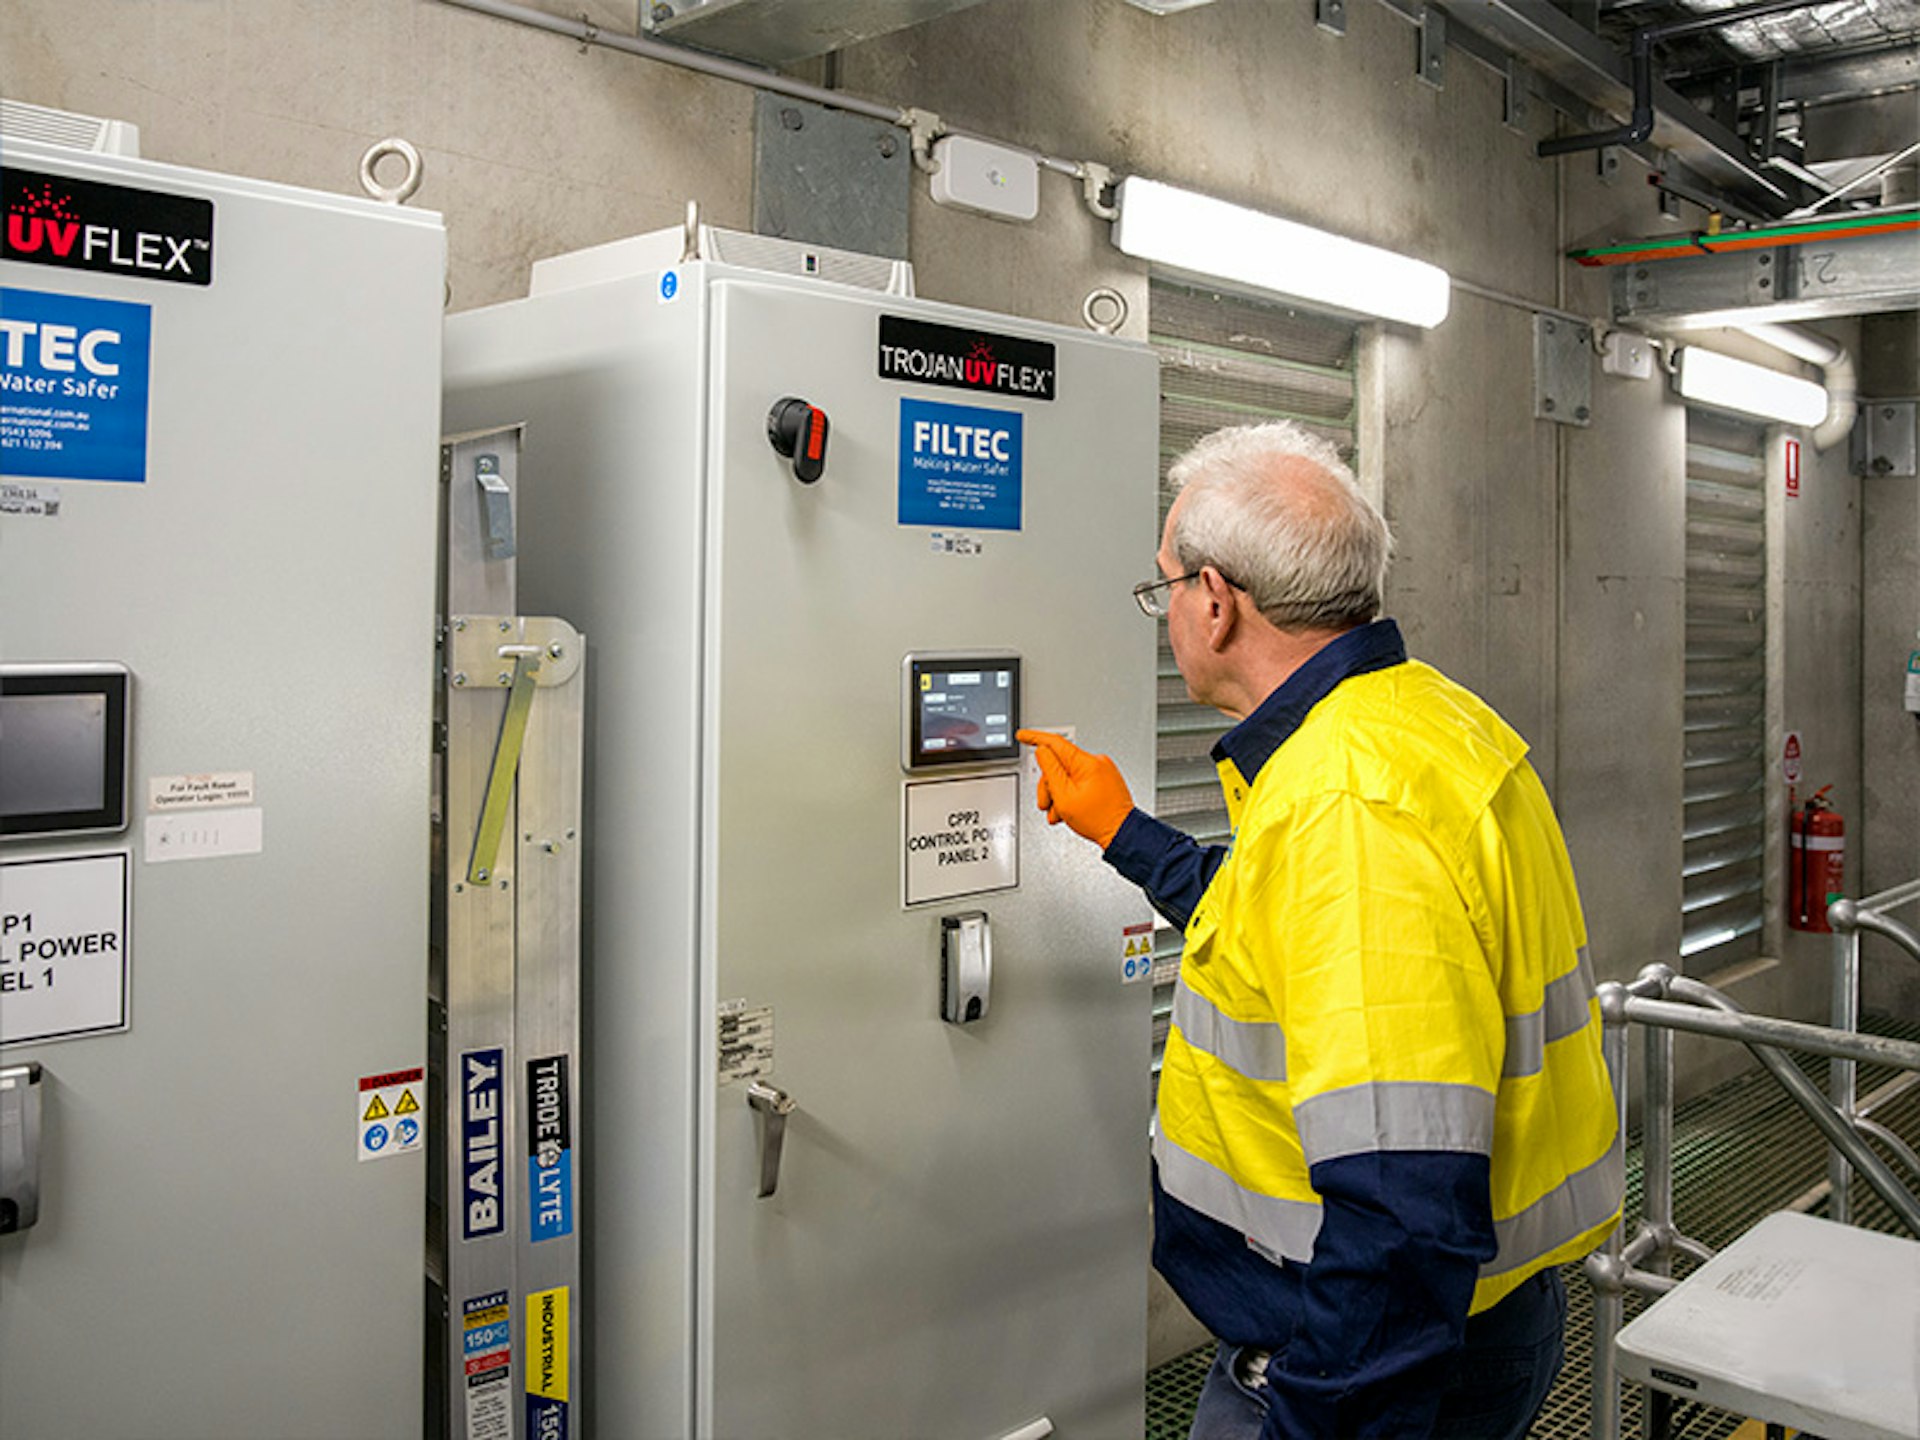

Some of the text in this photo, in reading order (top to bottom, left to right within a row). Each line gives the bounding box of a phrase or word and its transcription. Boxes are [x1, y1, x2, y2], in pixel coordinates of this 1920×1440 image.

[0, 317, 121, 377] TEC
[62, 377, 119, 399] Safer
[913, 420, 1010, 462] FILTEC
[948, 810, 980, 828] CPP2
[908, 830, 969, 852] CONTROL
[938, 846, 989, 867] PANEL 2
[3, 913, 32, 936] P1
[20, 931, 117, 963] POWER
[42, 966, 53, 988] 1
[536, 1060, 561, 1139] TRADE
[467, 1057, 499, 1233] BAILEY
[538, 1167, 563, 1227] LYTE
[541, 1293, 554, 1393] INDUSTRIAL
